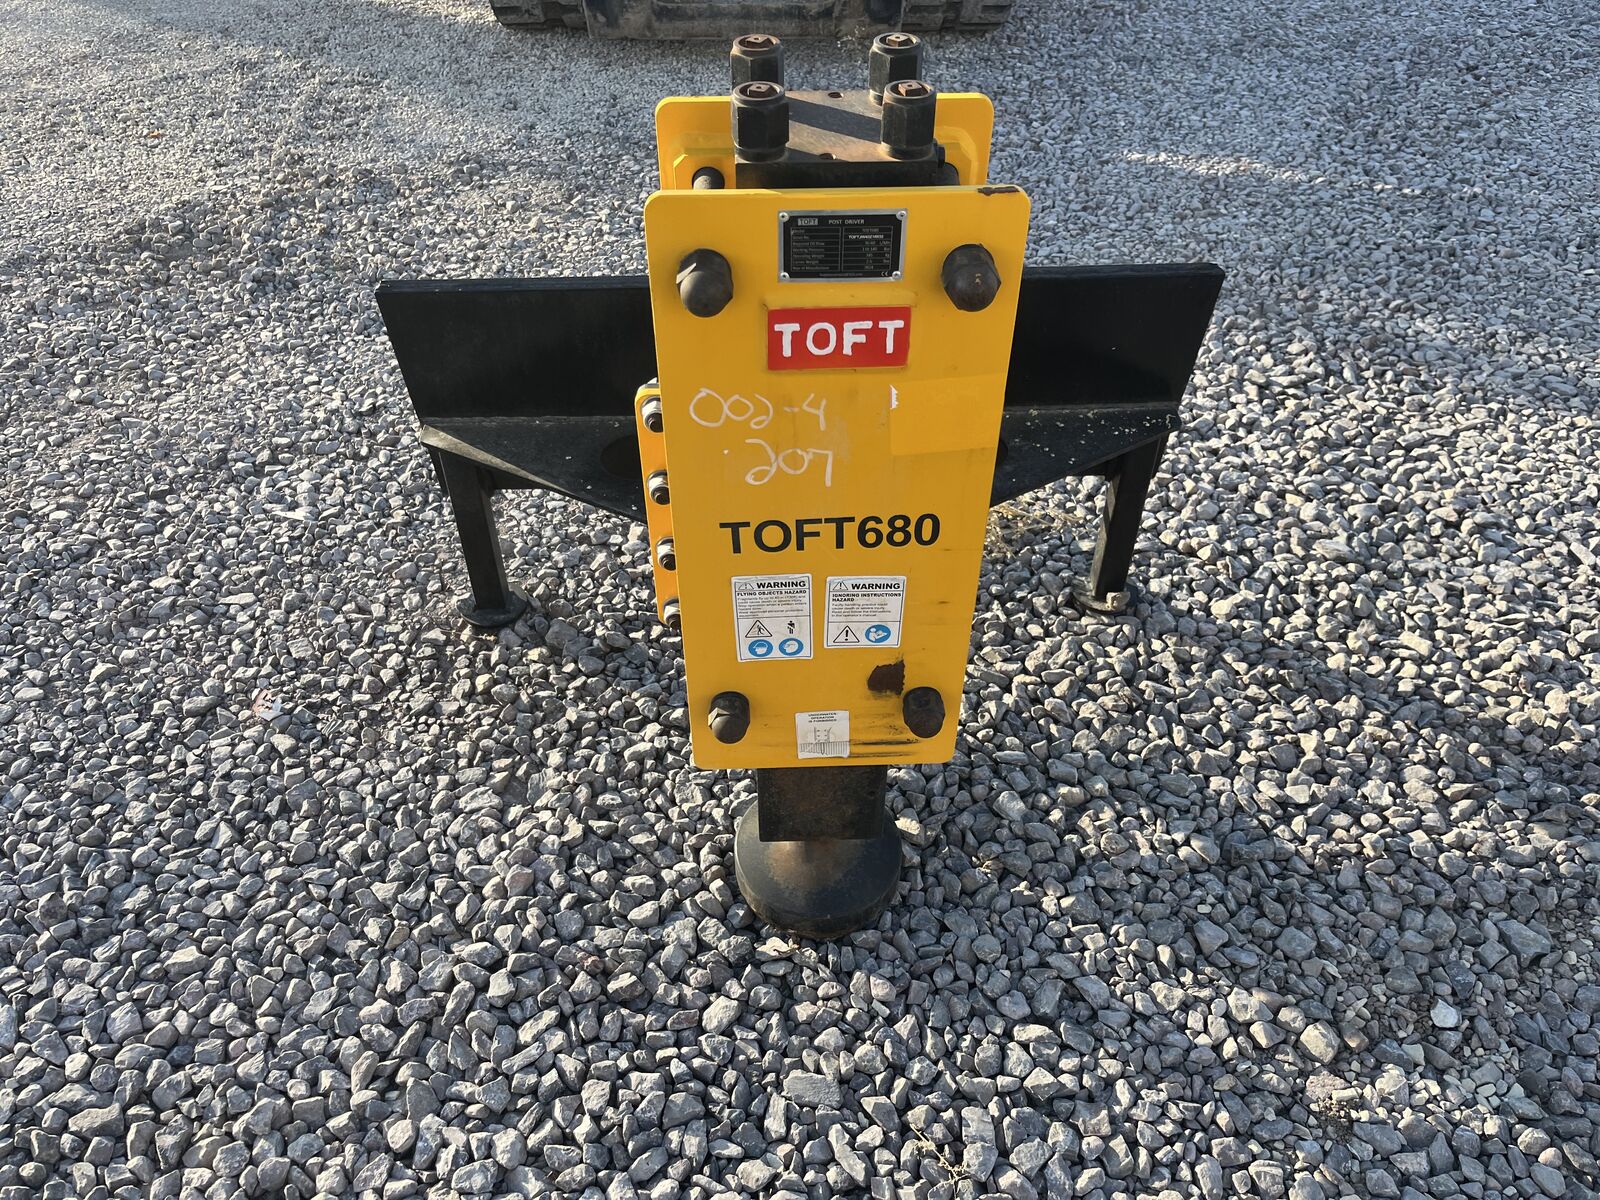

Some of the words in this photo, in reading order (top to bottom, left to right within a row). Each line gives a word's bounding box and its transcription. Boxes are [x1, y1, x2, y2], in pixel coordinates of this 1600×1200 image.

[774, 319, 905, 358] TOFT
[689, 387, 826, 431] 002-4
[745, 438, 833, 487] 207
[719, 513, 941, 554] TOFT680
[756, 580, 806, 589] WARNING
[851, 582, 900, 590] WARNING
